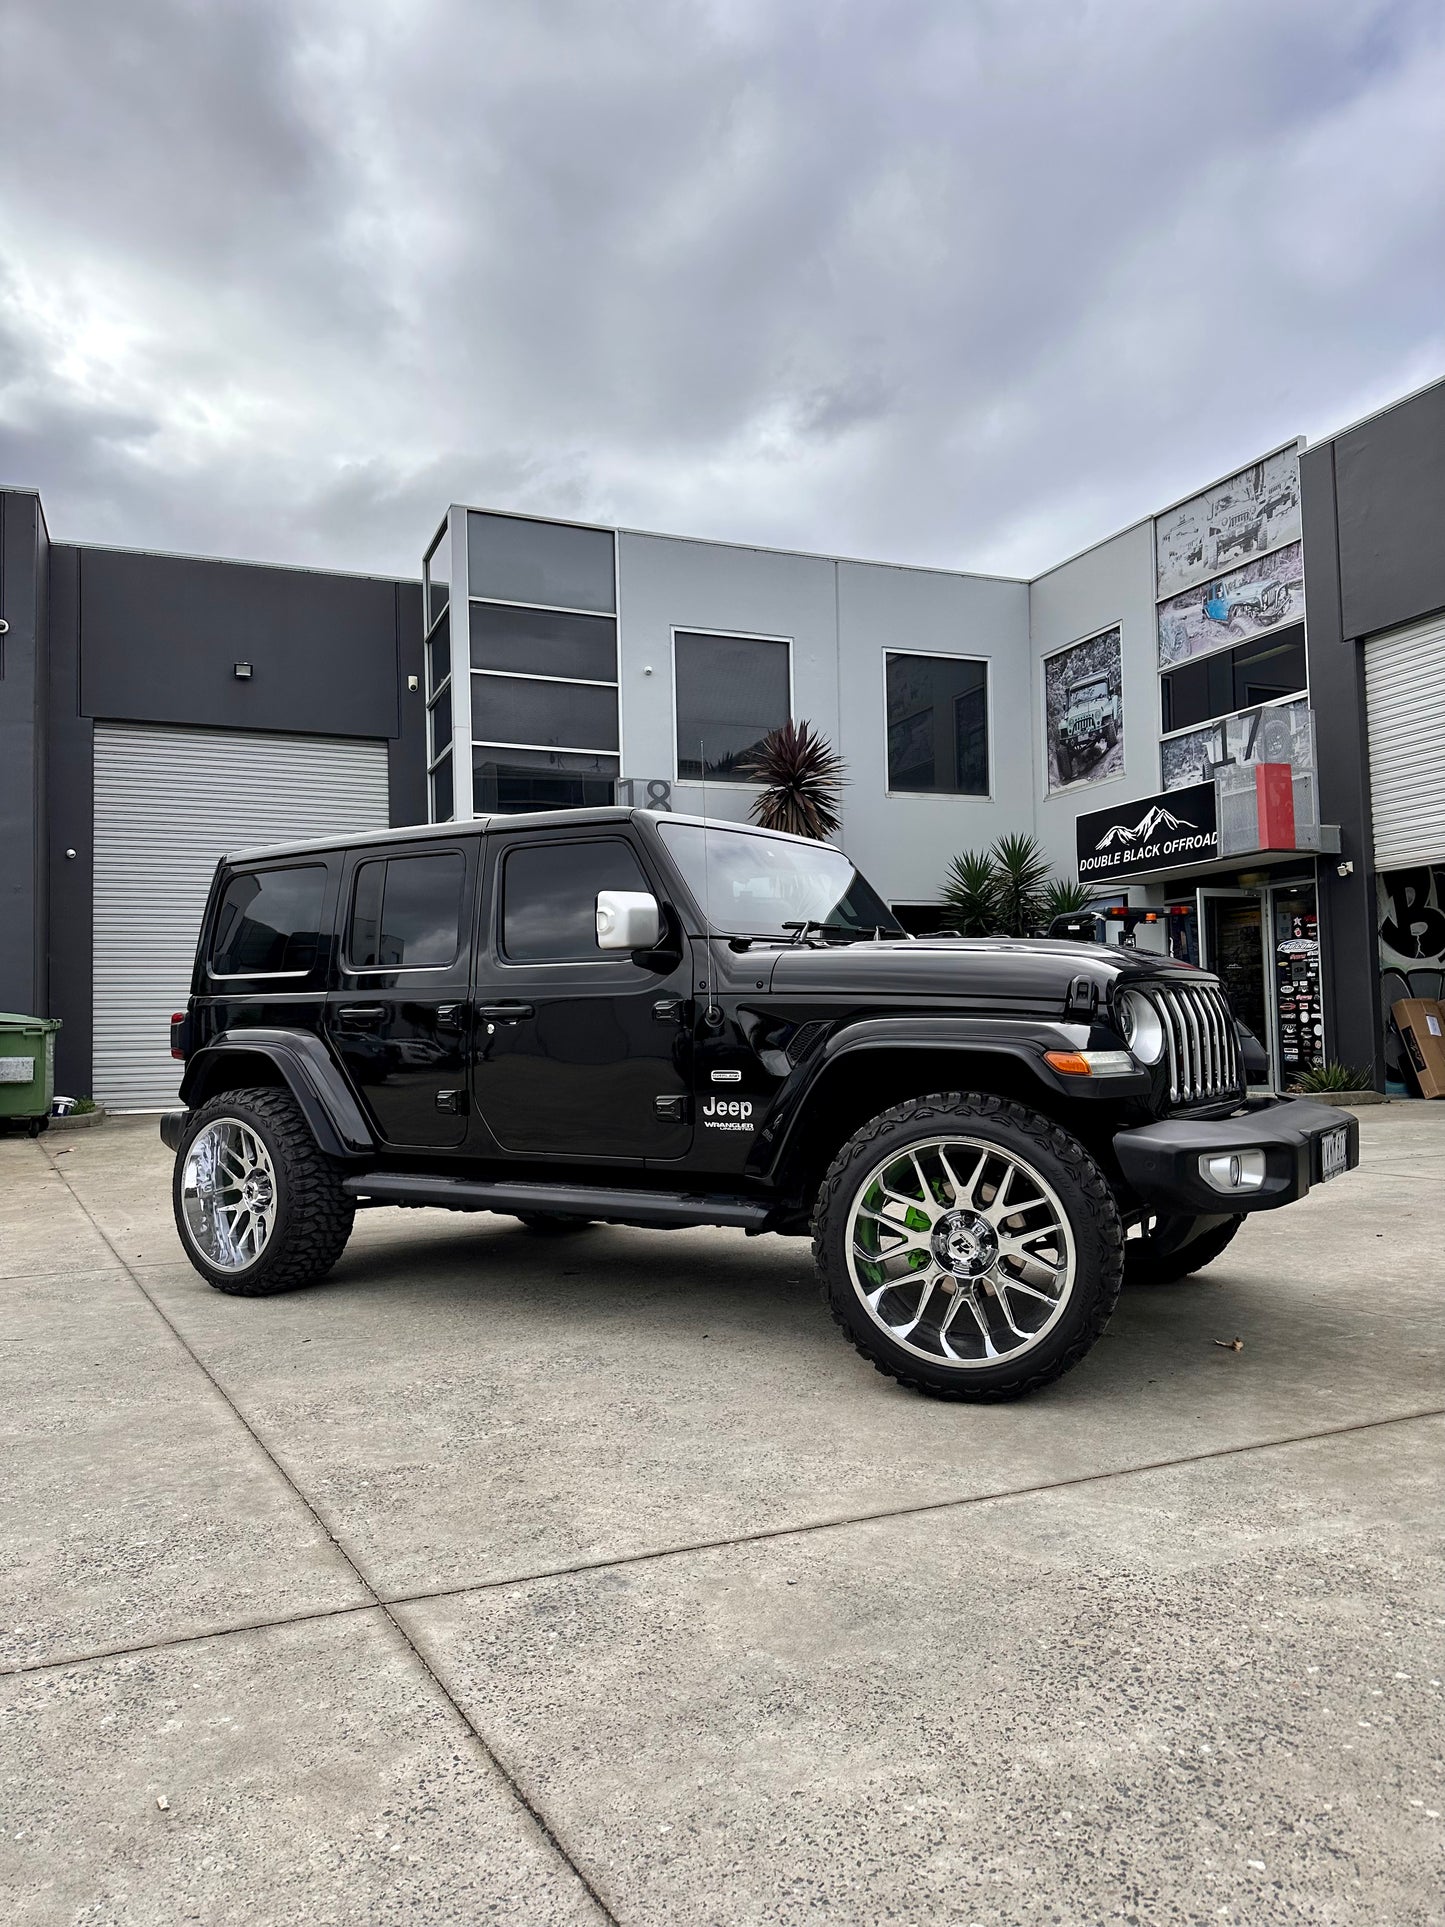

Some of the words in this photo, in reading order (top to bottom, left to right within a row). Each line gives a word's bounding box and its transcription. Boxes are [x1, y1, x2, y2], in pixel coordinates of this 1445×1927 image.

[1208, 707, 1262, 769] 17
[618, 779, 672, 812] 18
[1080, 852, 1121, 871] DOUBLE
[1123, 843, 1160, 863] BLACK
[1163, 831, 1218, 854] OFFROAD
[703, 1096, 752, 1119] Jeep
